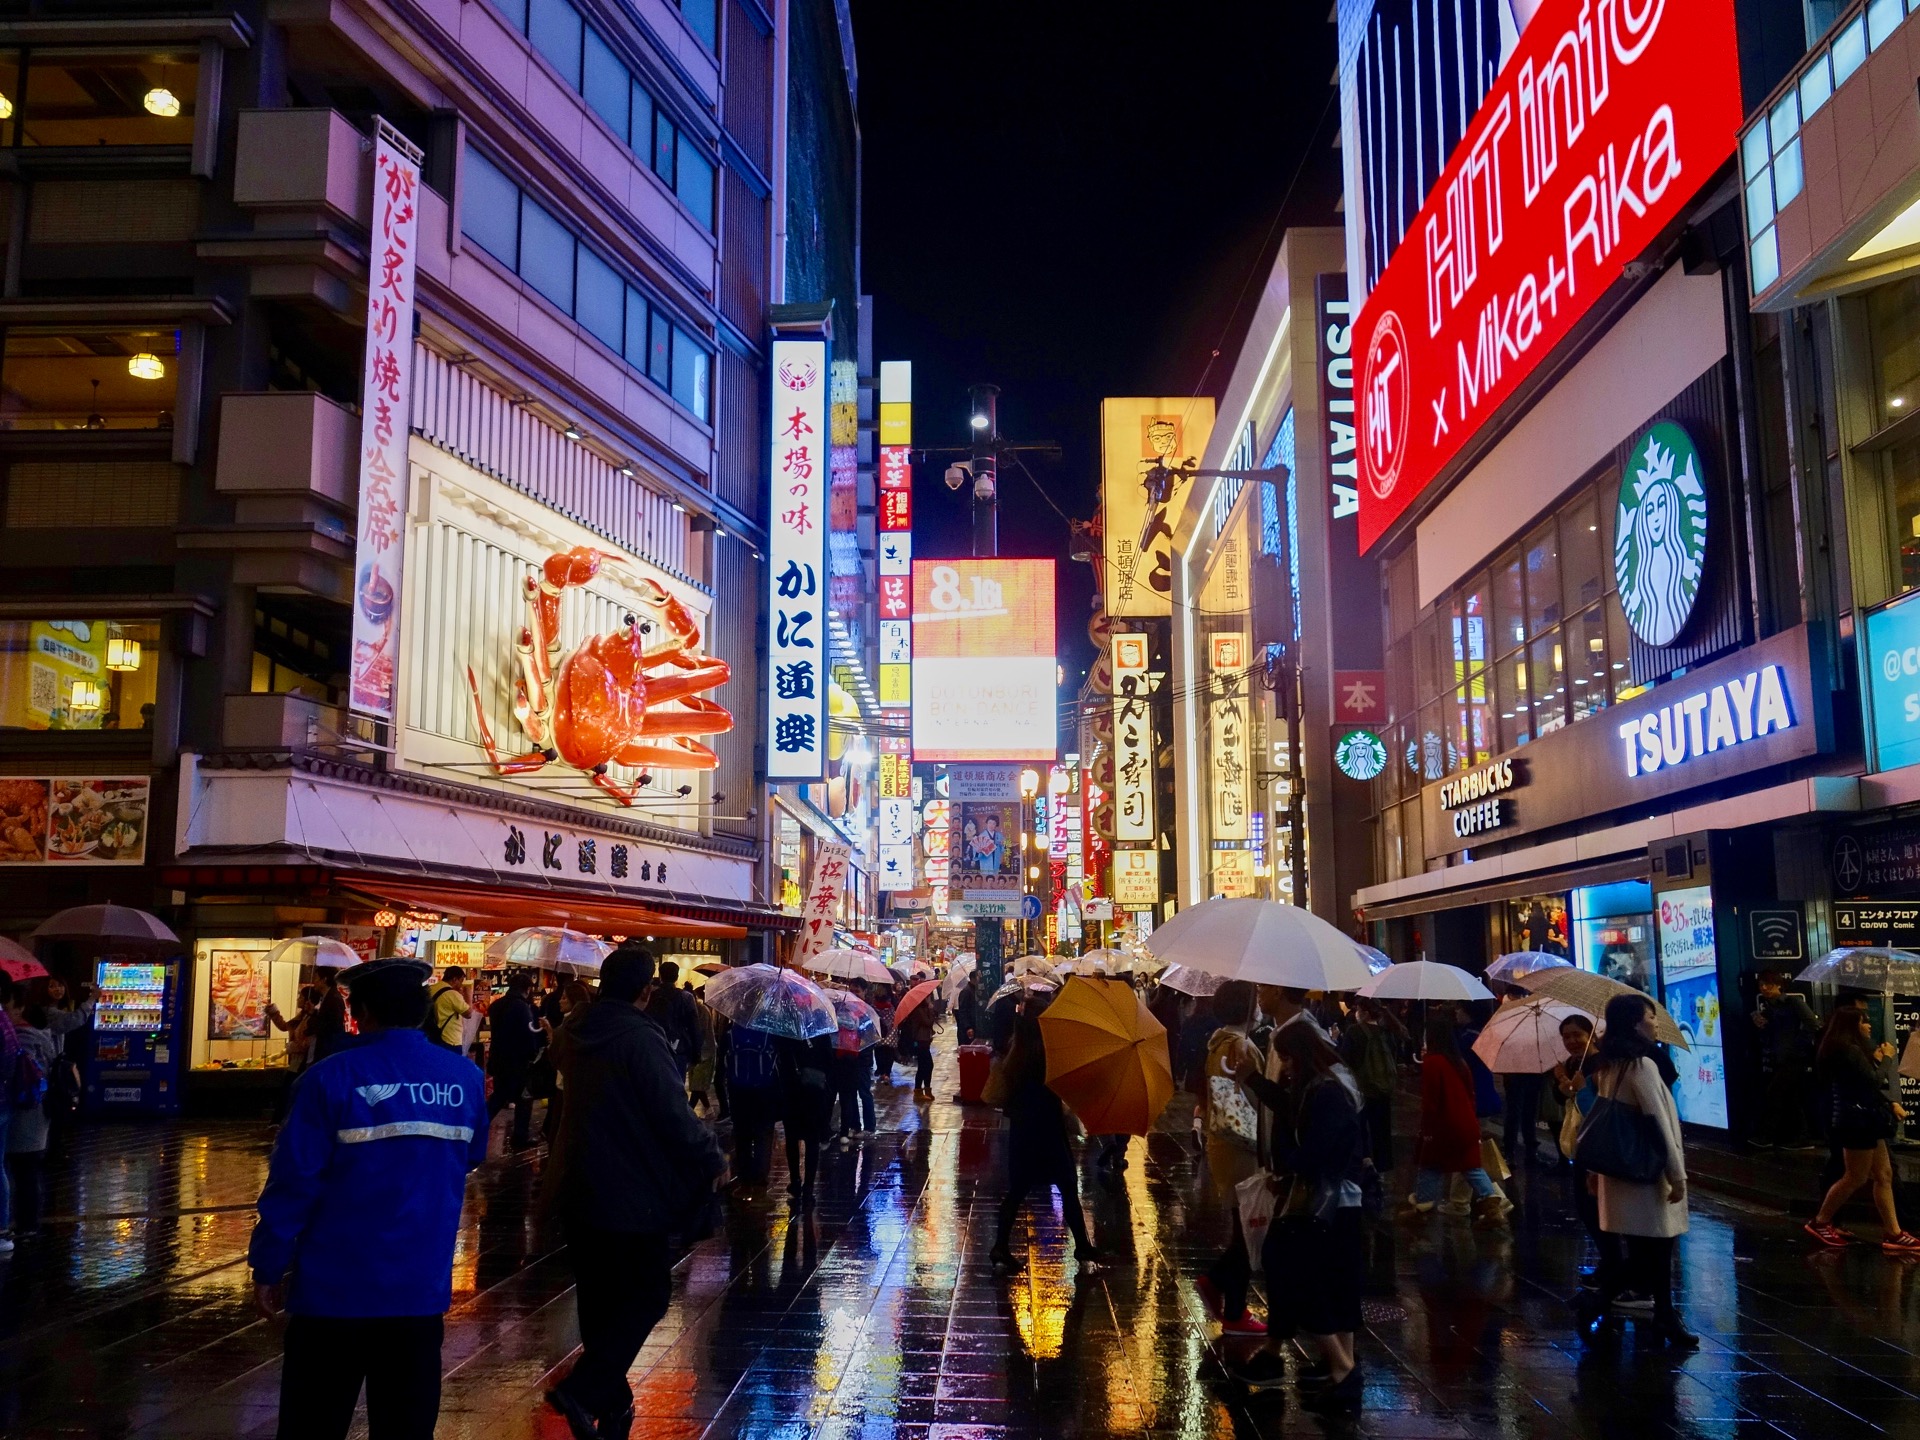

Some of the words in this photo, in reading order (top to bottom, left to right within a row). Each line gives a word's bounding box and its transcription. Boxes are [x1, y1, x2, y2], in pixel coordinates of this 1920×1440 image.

[1425, 94, 1512, 338] HIT
[1517, 0, 1665, 208] info
[1433, 389, 1449, 447] x
[1456, 104, 1682, 420] Mika+Rika
[363, 161, 411, 553] かに炙り焼き会席
[780, 407, 814, 535] 本場の味
[1117, 540, 1133, 600] 道頓堀店
[884, 578, 907, 616] はや
[890, 624, 909, 661] 白木屋
[1883, 646, 1920, 681] @c
[1343, 680, 1377, 713] 本
[1620, 664, 1790, 777] TSUTAYA
[953, 771, 1017, 782] 道頓堀商店会
[1440, 758, 1513, 811] STARBUCKS
[1453, 798, 1501, 838] COFFEE
[802, 857, 843, 956] 松葉かに
[1841, 914, 1851, 926] 4
[1860, 911, 1918, 919] エンタメフロア
[1893, 921, 1915, 929] Comic
[1895, 1012, 1919, 1021] フェの
[403, 1082, 464, 1107] TOHO
